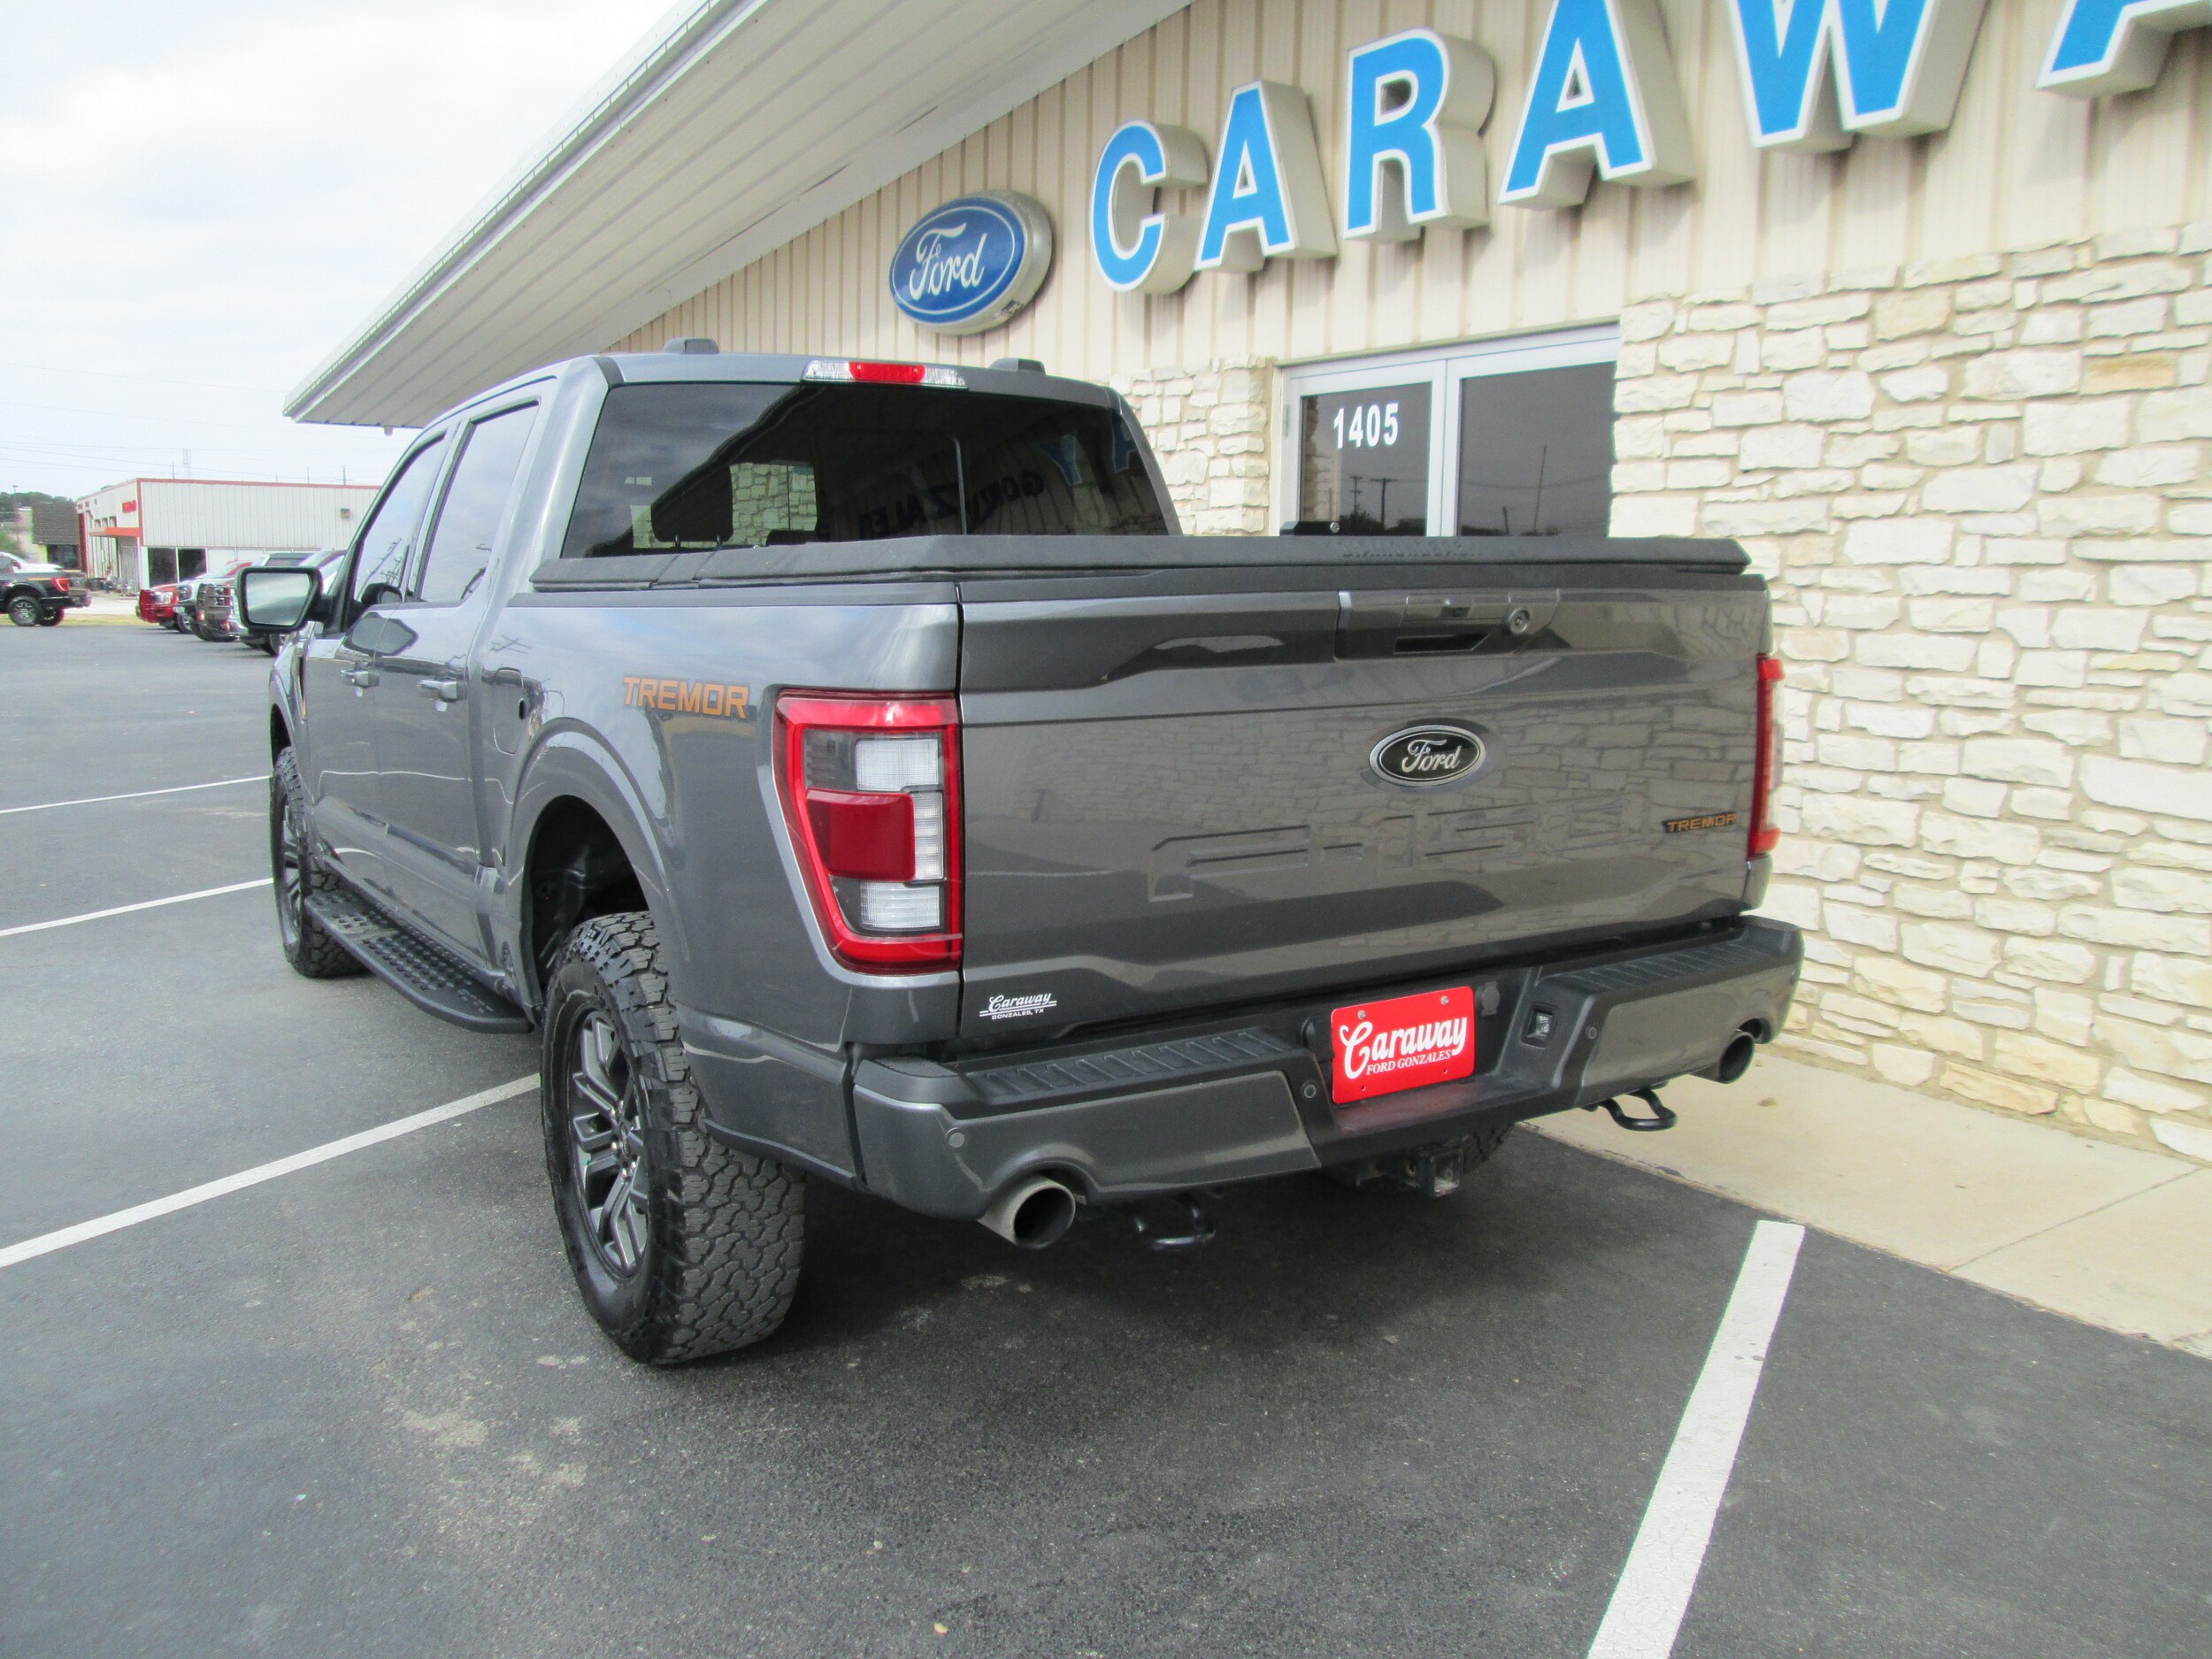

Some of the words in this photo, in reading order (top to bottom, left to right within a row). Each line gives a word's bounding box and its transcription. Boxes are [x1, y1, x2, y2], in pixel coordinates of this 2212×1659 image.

[1089, 0, 2212, 292] CARAW
[909, 222, 987, 300] Ford
[1333, 403, 1399, 449] 1405
[622, 676, 749, 719] TREMOR
[1402, 739, 1462, 772] Ford
[1667, 812, 1739, 832] TREMOR
[988, 993, 1052, 1012] Caraway
[992, 1010, 1033, 1020] GONZALES,
[1340, 1018, 1467, 1079] Caraway
[1366, 1060, 1395, 1075] FORD
[1397, 1049, 1453, 1069] GONZALES
